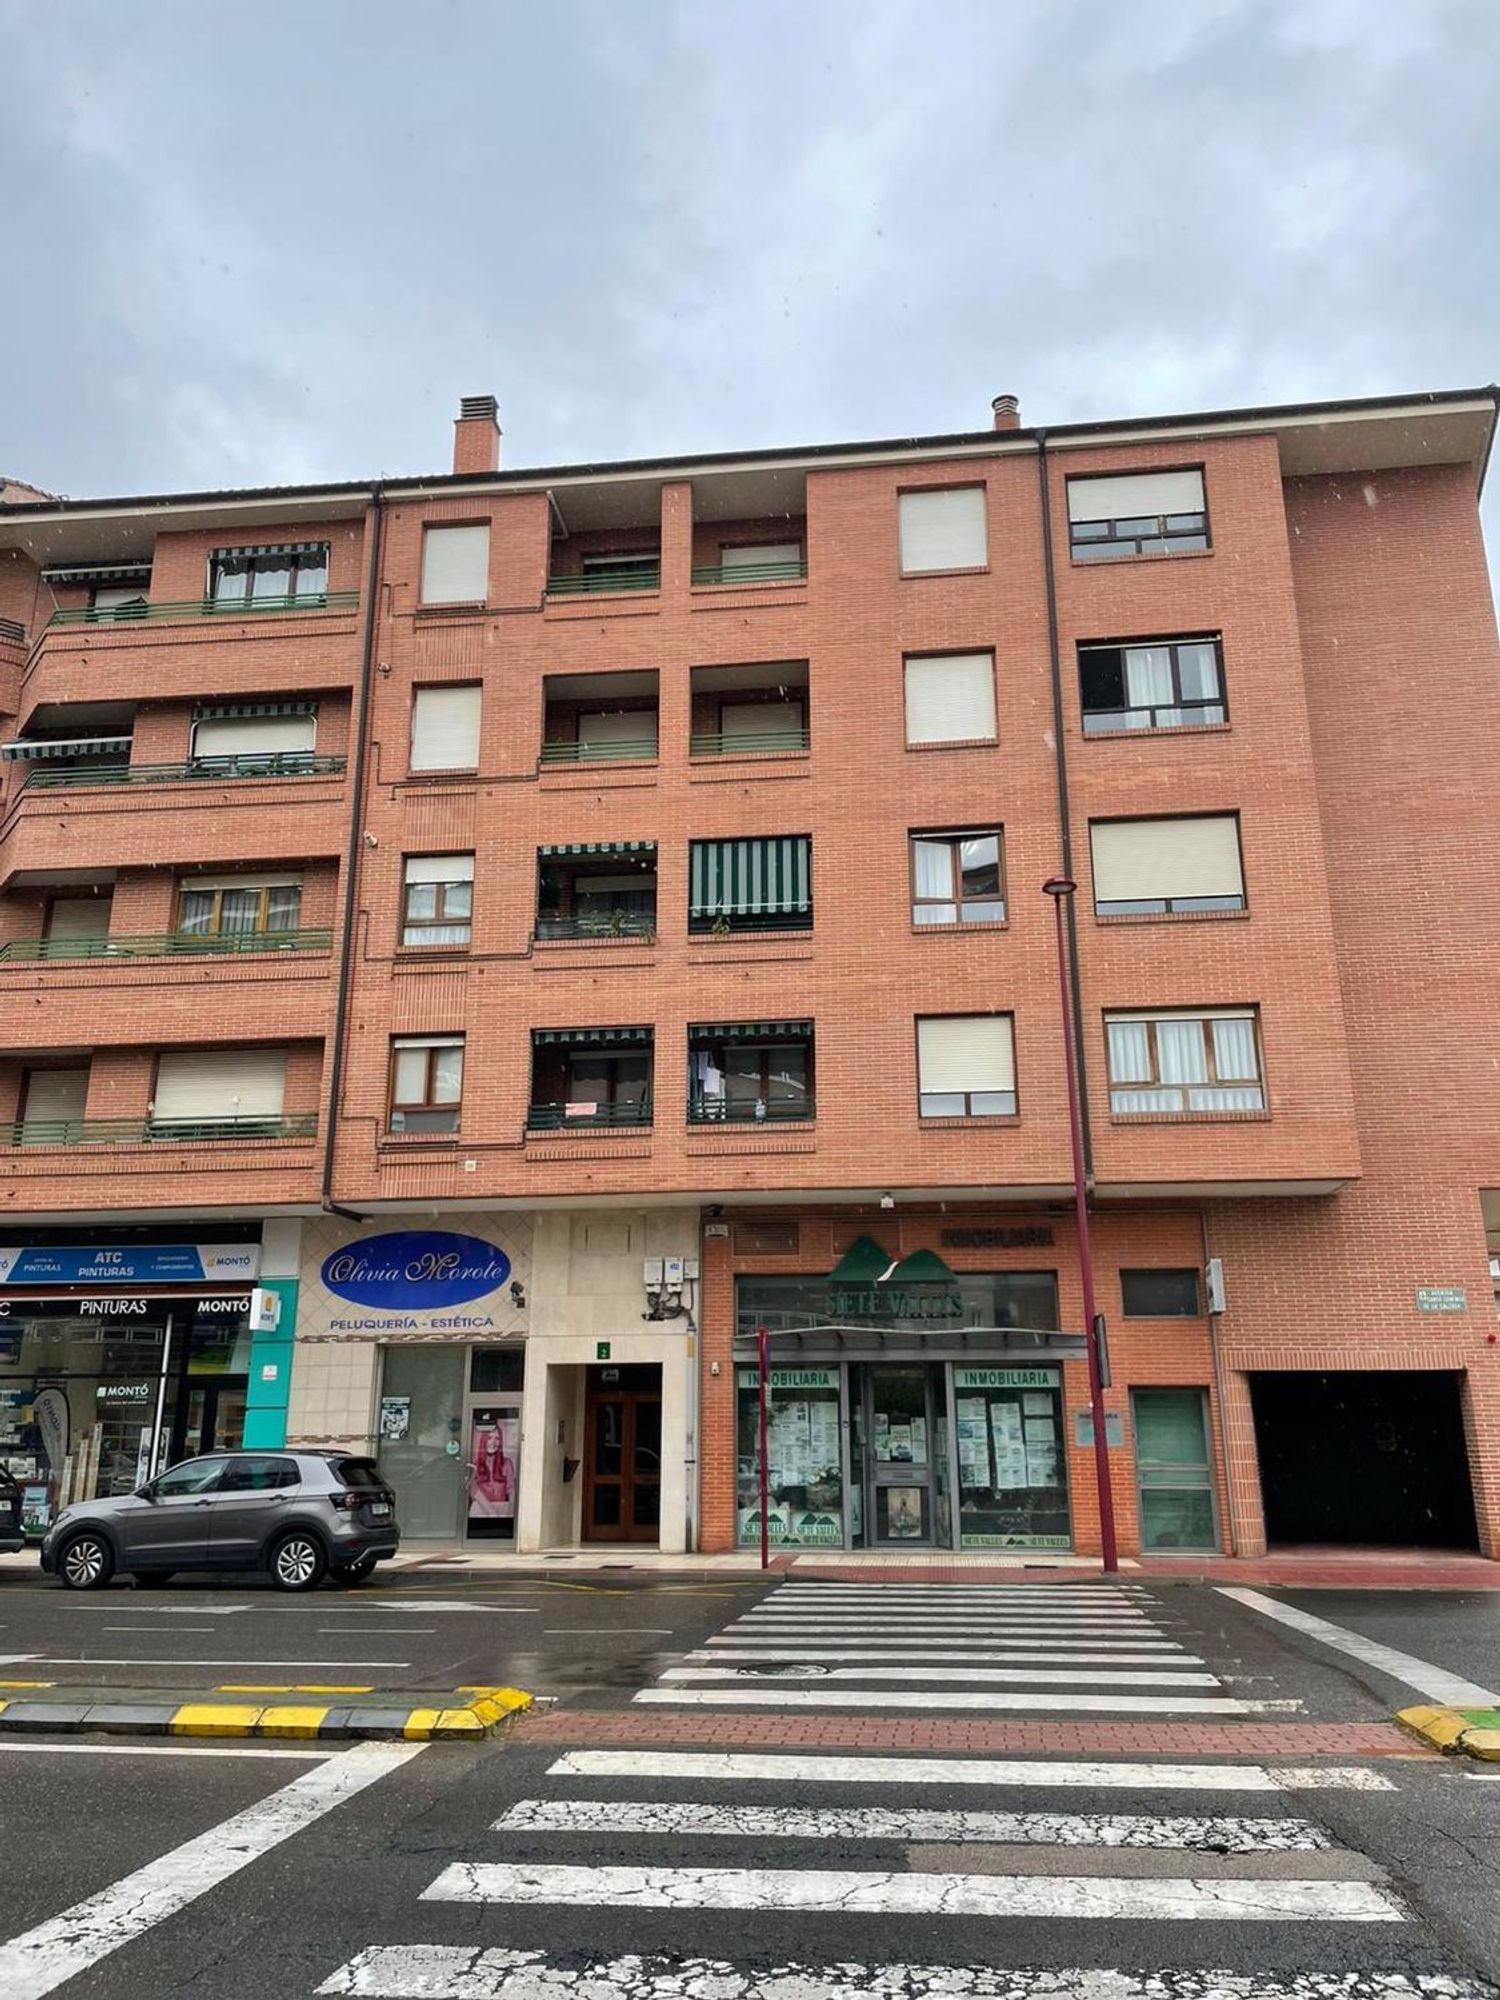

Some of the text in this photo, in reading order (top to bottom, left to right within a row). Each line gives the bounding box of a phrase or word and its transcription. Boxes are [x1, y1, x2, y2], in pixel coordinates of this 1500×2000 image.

[94, 1252, 122, 1263] ATC
[216, 1255, 251, 1265] MONTÓ
[78, 1267, 134, 1277] PINTURAS
[328, 1254, 400, 1283] Olivia
[80, 1300, 147, 1315] PINTURAS
[197, 1297, 250, 1312] MONTÓ
[330, 1316, 418, 1330] PELUQUERÍA
[431, 1315, 494, 1328] ESTÉTICA
[748, 1372, 829, 1386] INOBILIARIA
[965, 1372, 1049, 1385] INMOBILIARIA
[107, 1383, 149, 1397] MONTÓ
